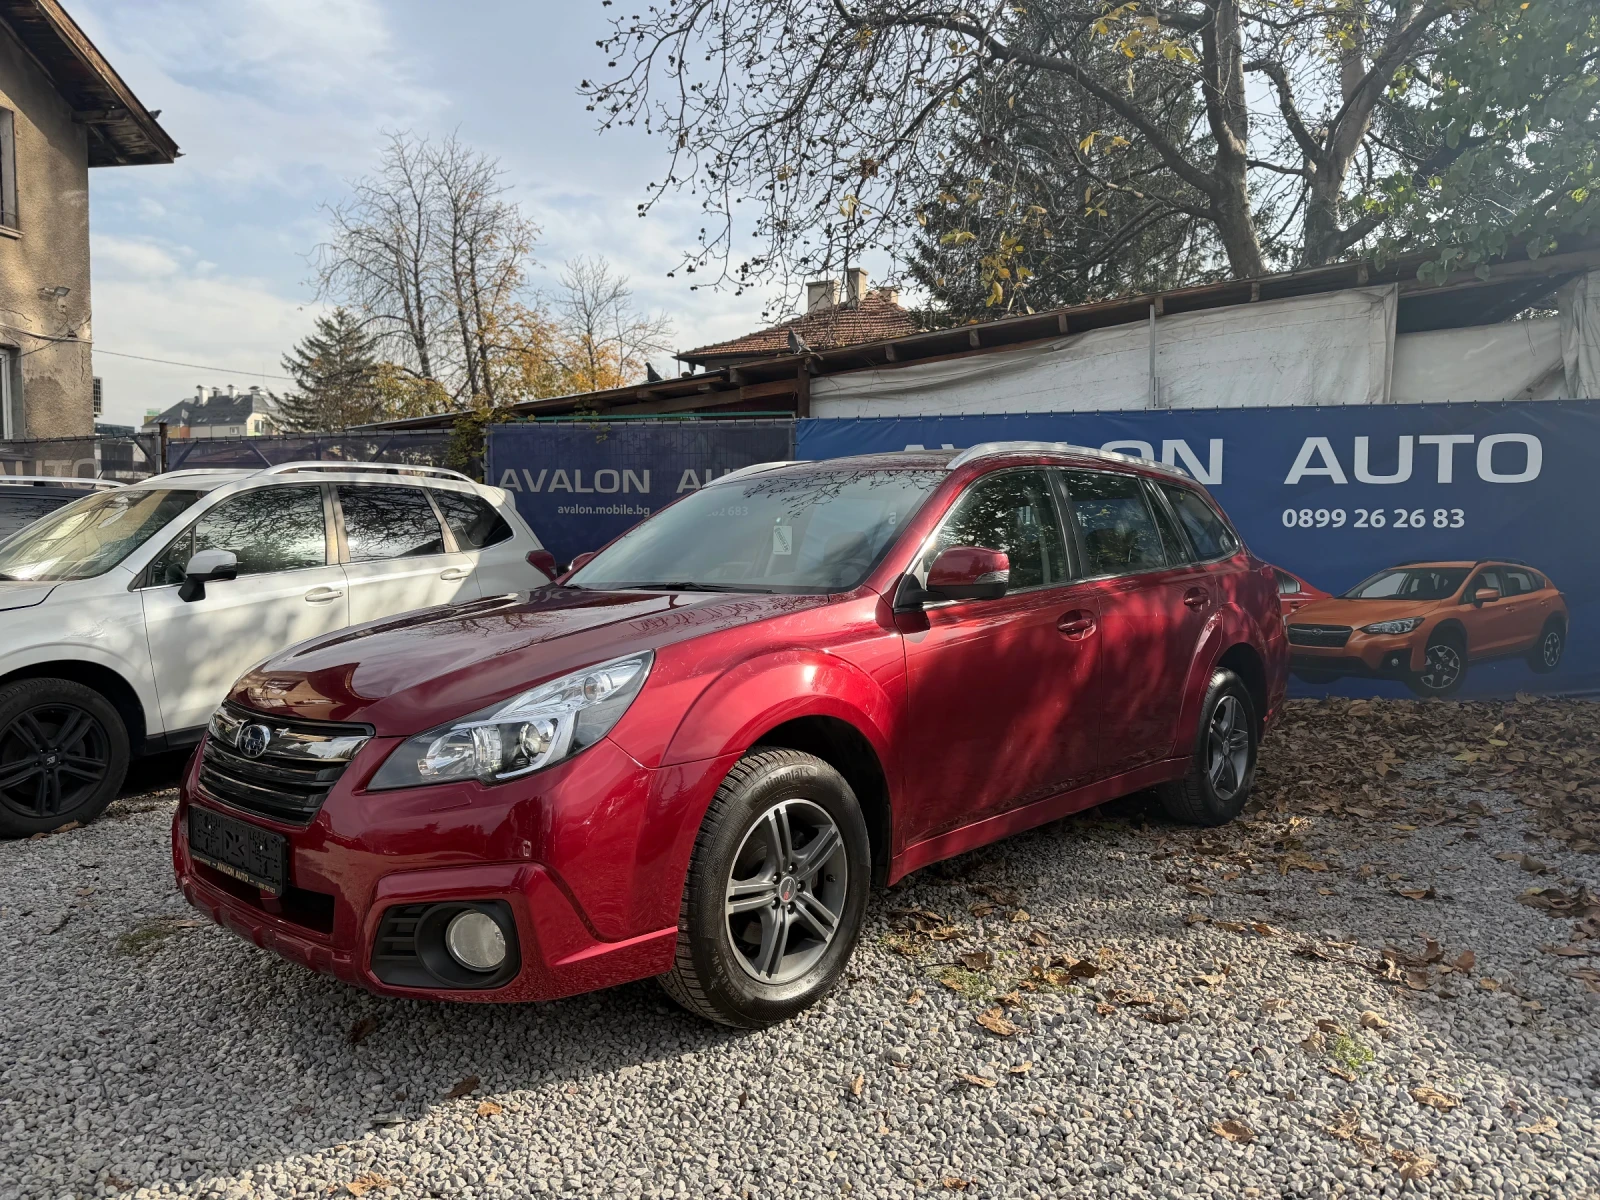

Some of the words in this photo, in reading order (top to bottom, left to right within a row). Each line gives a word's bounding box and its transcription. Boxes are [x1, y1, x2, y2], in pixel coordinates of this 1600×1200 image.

[1284, 433, 1543, 484] AUTO
[0, 458, 99, 489] UTO
[499, 469, 650, 494] AVALON
[557, 504, 650, 517] avalon.mobile.bg
[728, 506, 748, 516] 683
[1282, 508, 1347, 528] 0899
[1353, 508, 1386, 528] 26
[1393, 508, 1426, 528] 26
[1432, 508, 1465, 528] 83
[751, 767, 803, 801] Continental
